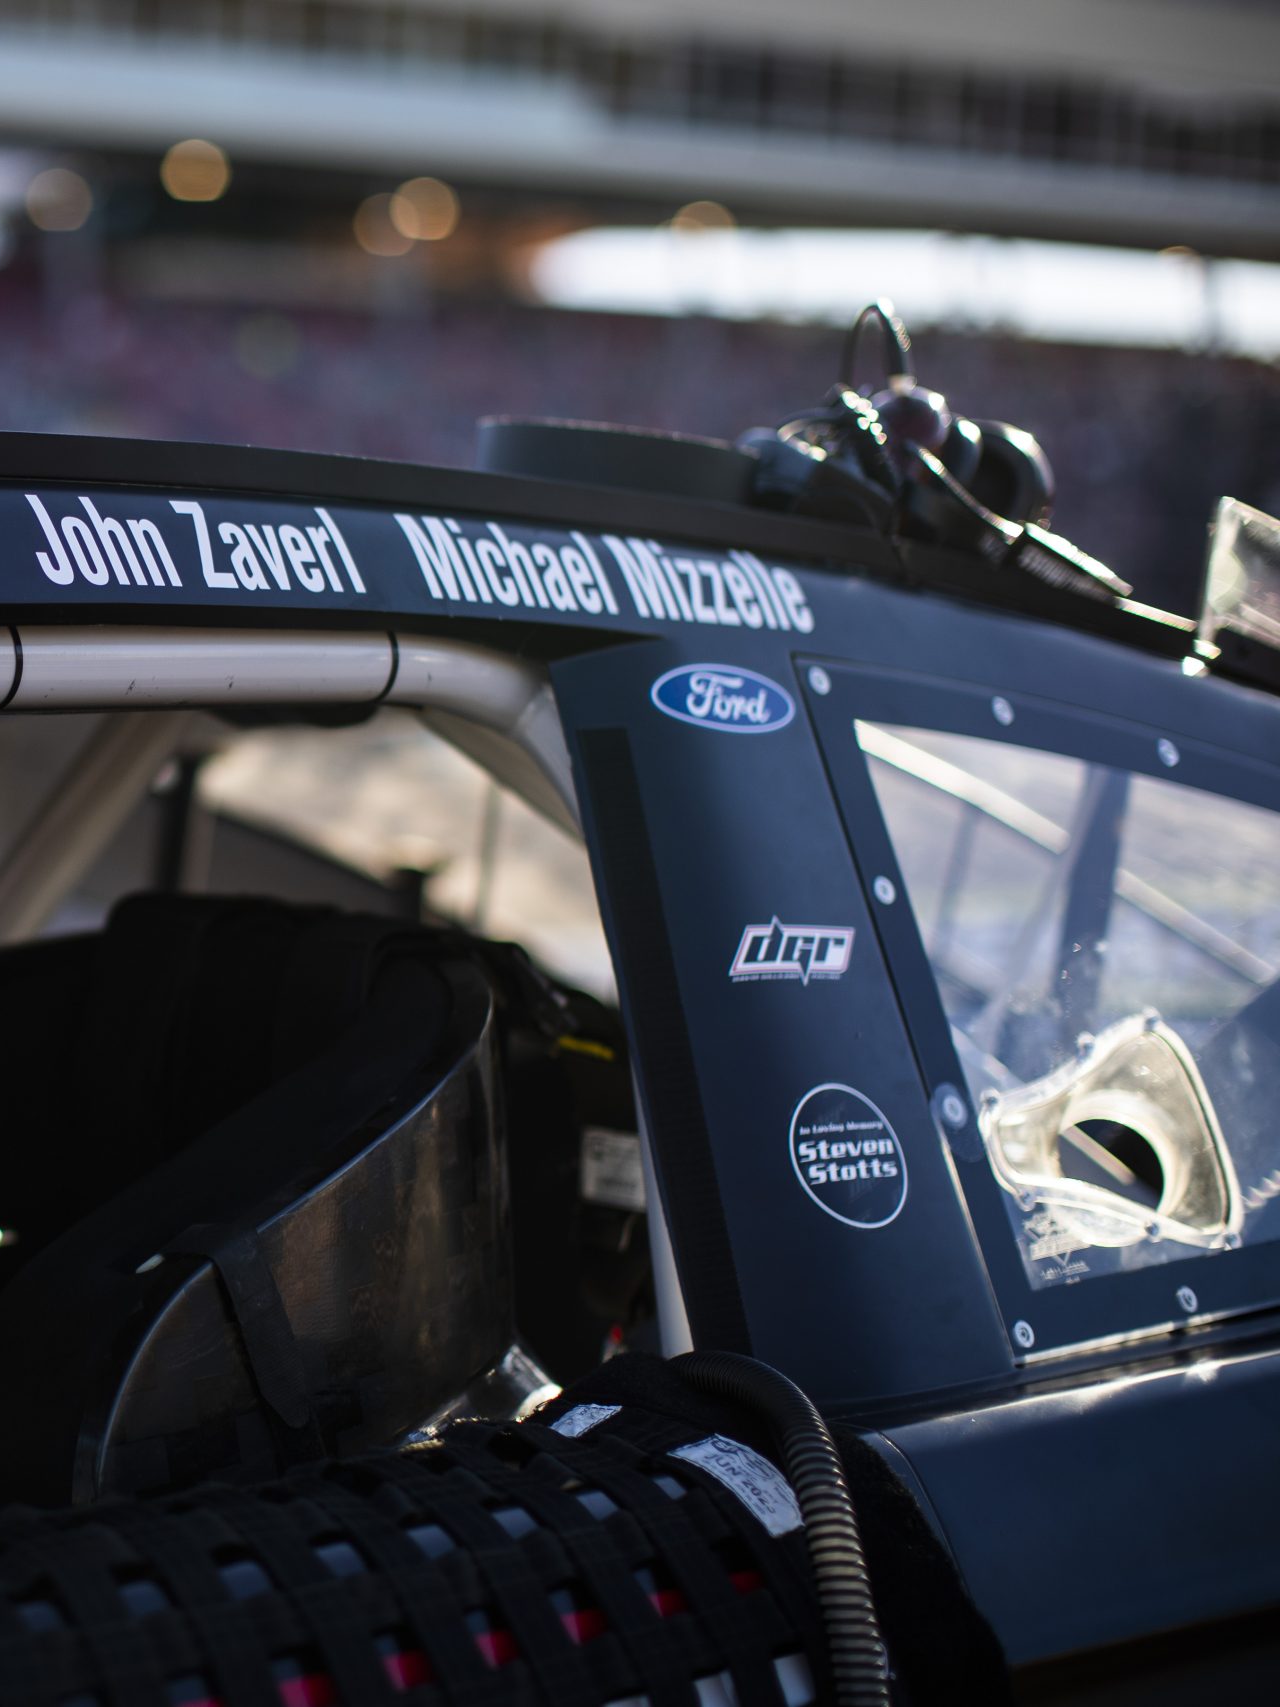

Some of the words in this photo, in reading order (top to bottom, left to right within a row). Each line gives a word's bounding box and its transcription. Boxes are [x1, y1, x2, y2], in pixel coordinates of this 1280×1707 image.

[24, 494, 183, 587] John
[169, 500, 367, 594] Zaverl
[393, 513, 619, 615] Michael
[601, 534, 815, 633] Mizzelle
[686, 671, 772, 723] Ford
[799, 1126, 811, 1136] In
[812, 1122, 845, 1135] Loving
[846, 1121, 883, 1131] Memory
[798, 1139, 895, 1163] Steven
[808, 1158, 898, 1185] Stotts
[704, 1454, 742, 1477] JUN
